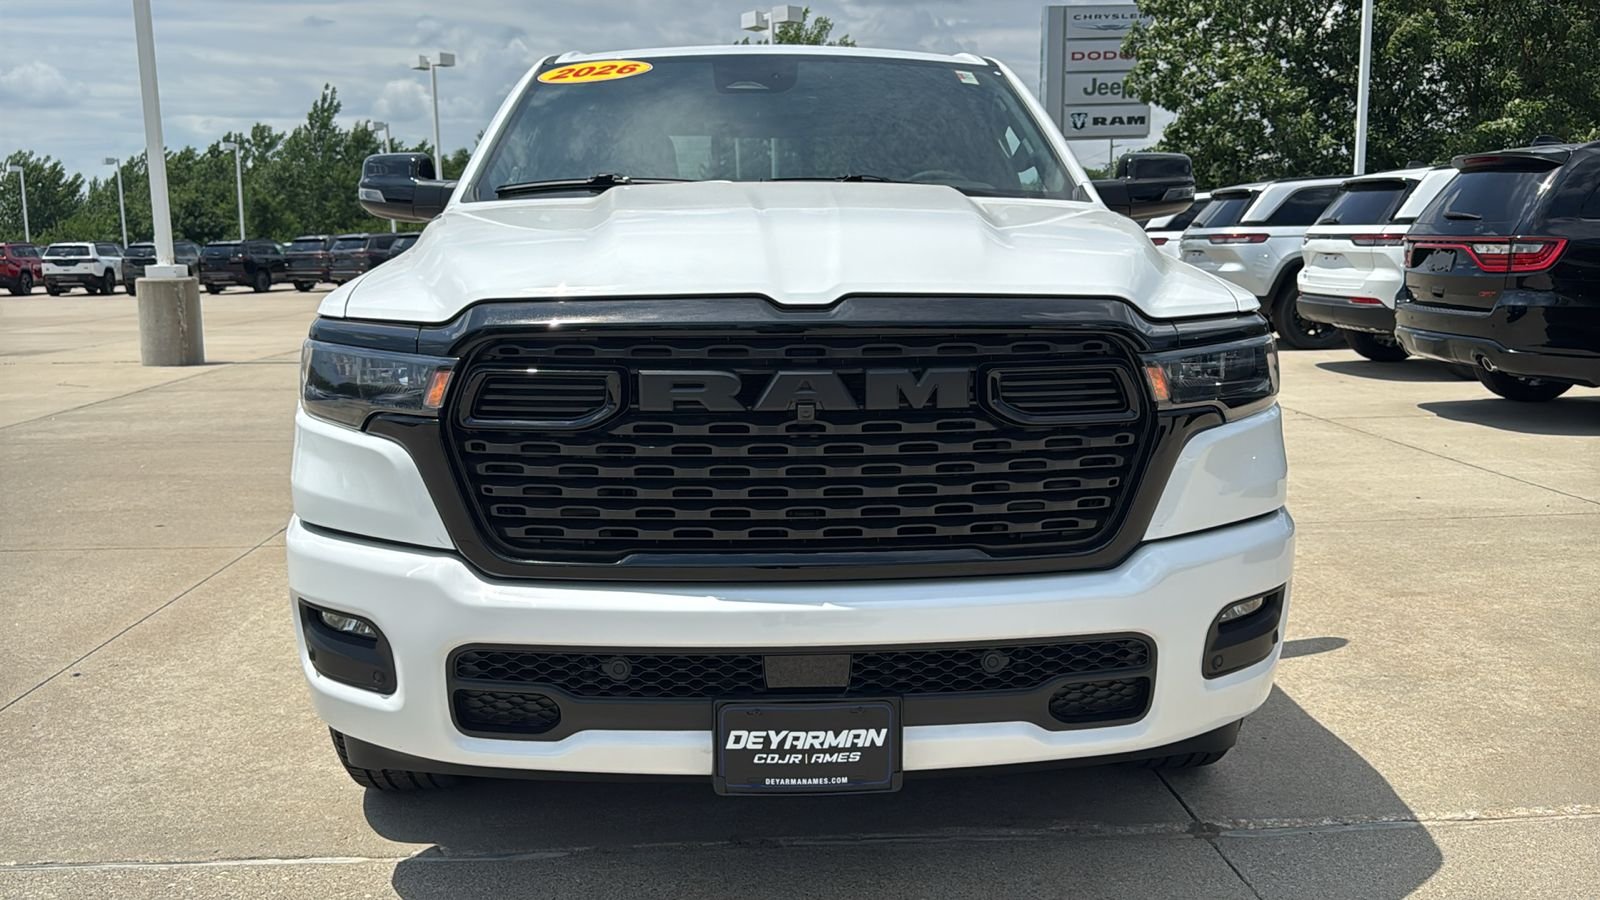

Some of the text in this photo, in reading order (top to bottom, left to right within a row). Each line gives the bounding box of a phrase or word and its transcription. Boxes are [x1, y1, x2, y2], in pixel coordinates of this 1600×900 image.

[548, 64, 641, 81] 2026
[1092, 116, 1146, 126] RAM
[638, 369, 970, 411] RAM
[725, 728, 888, 750] DEYARMAN
[753, 752, 861, 764] CDJR AMES
[765, 776, 848, 786] DEYARMANAMES.COM
